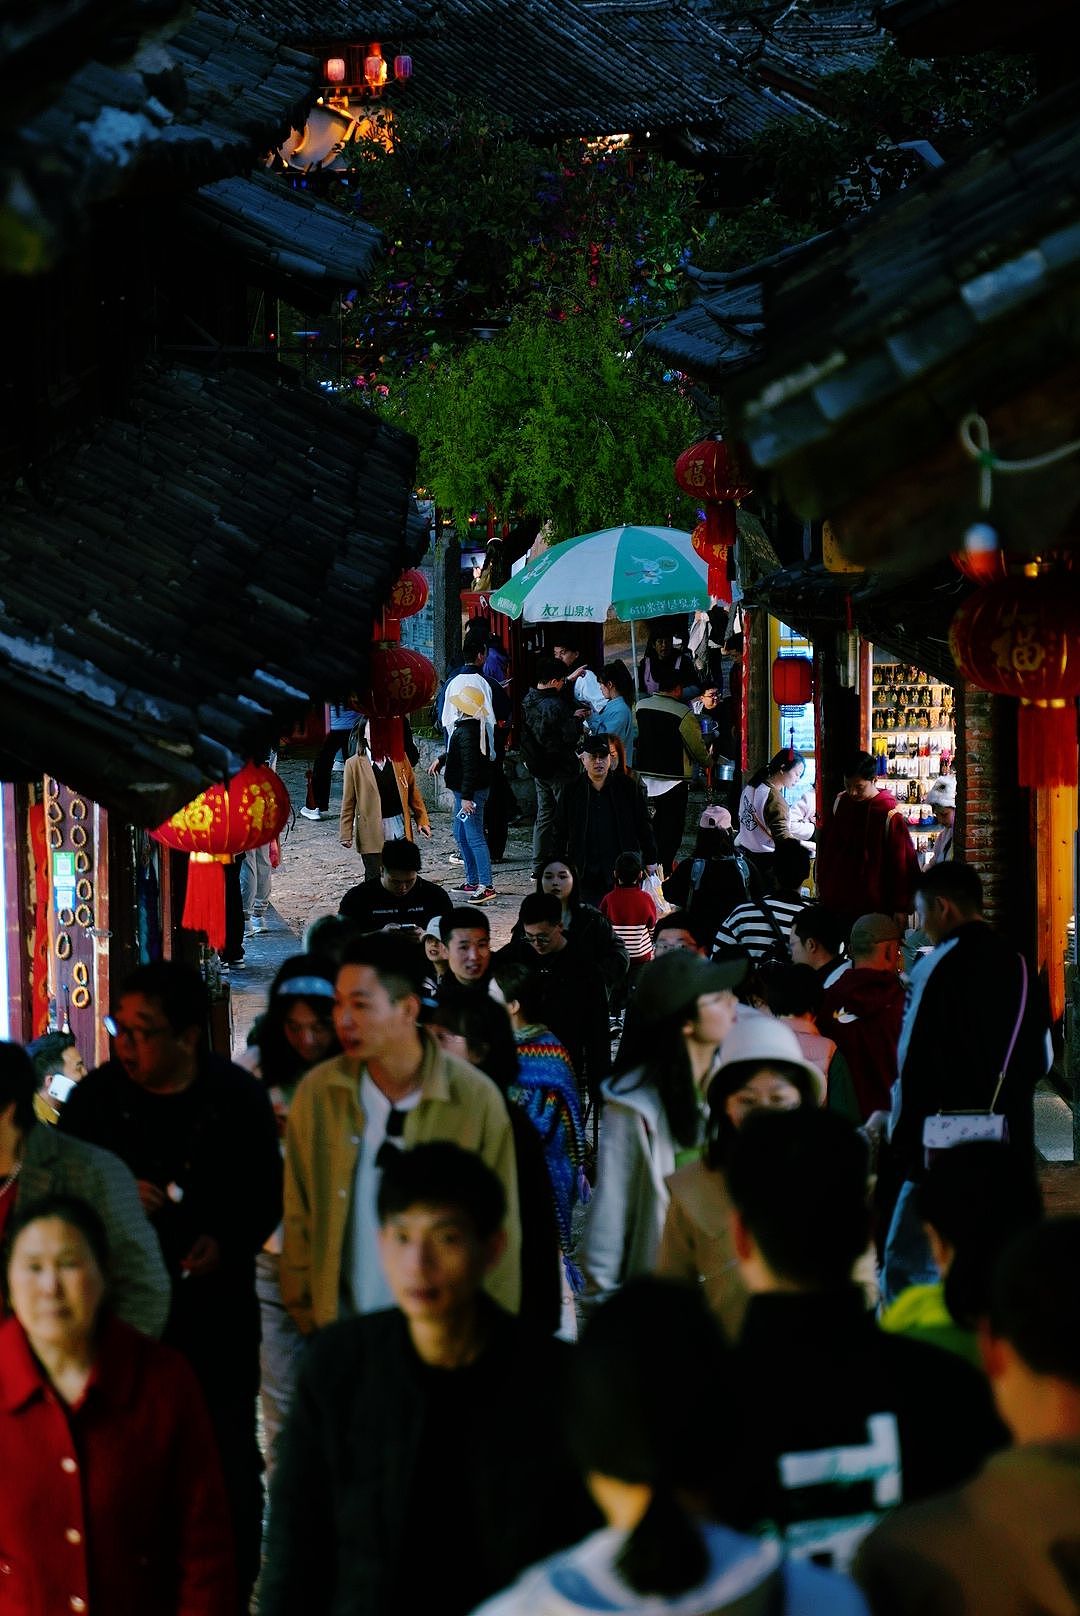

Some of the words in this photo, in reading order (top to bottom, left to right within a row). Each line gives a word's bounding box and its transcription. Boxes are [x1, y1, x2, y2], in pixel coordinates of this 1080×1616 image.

[391, 580, 415, 606] 福
[991, 612, 1046, 672] 福
[387, 667, 417, 700] 福
